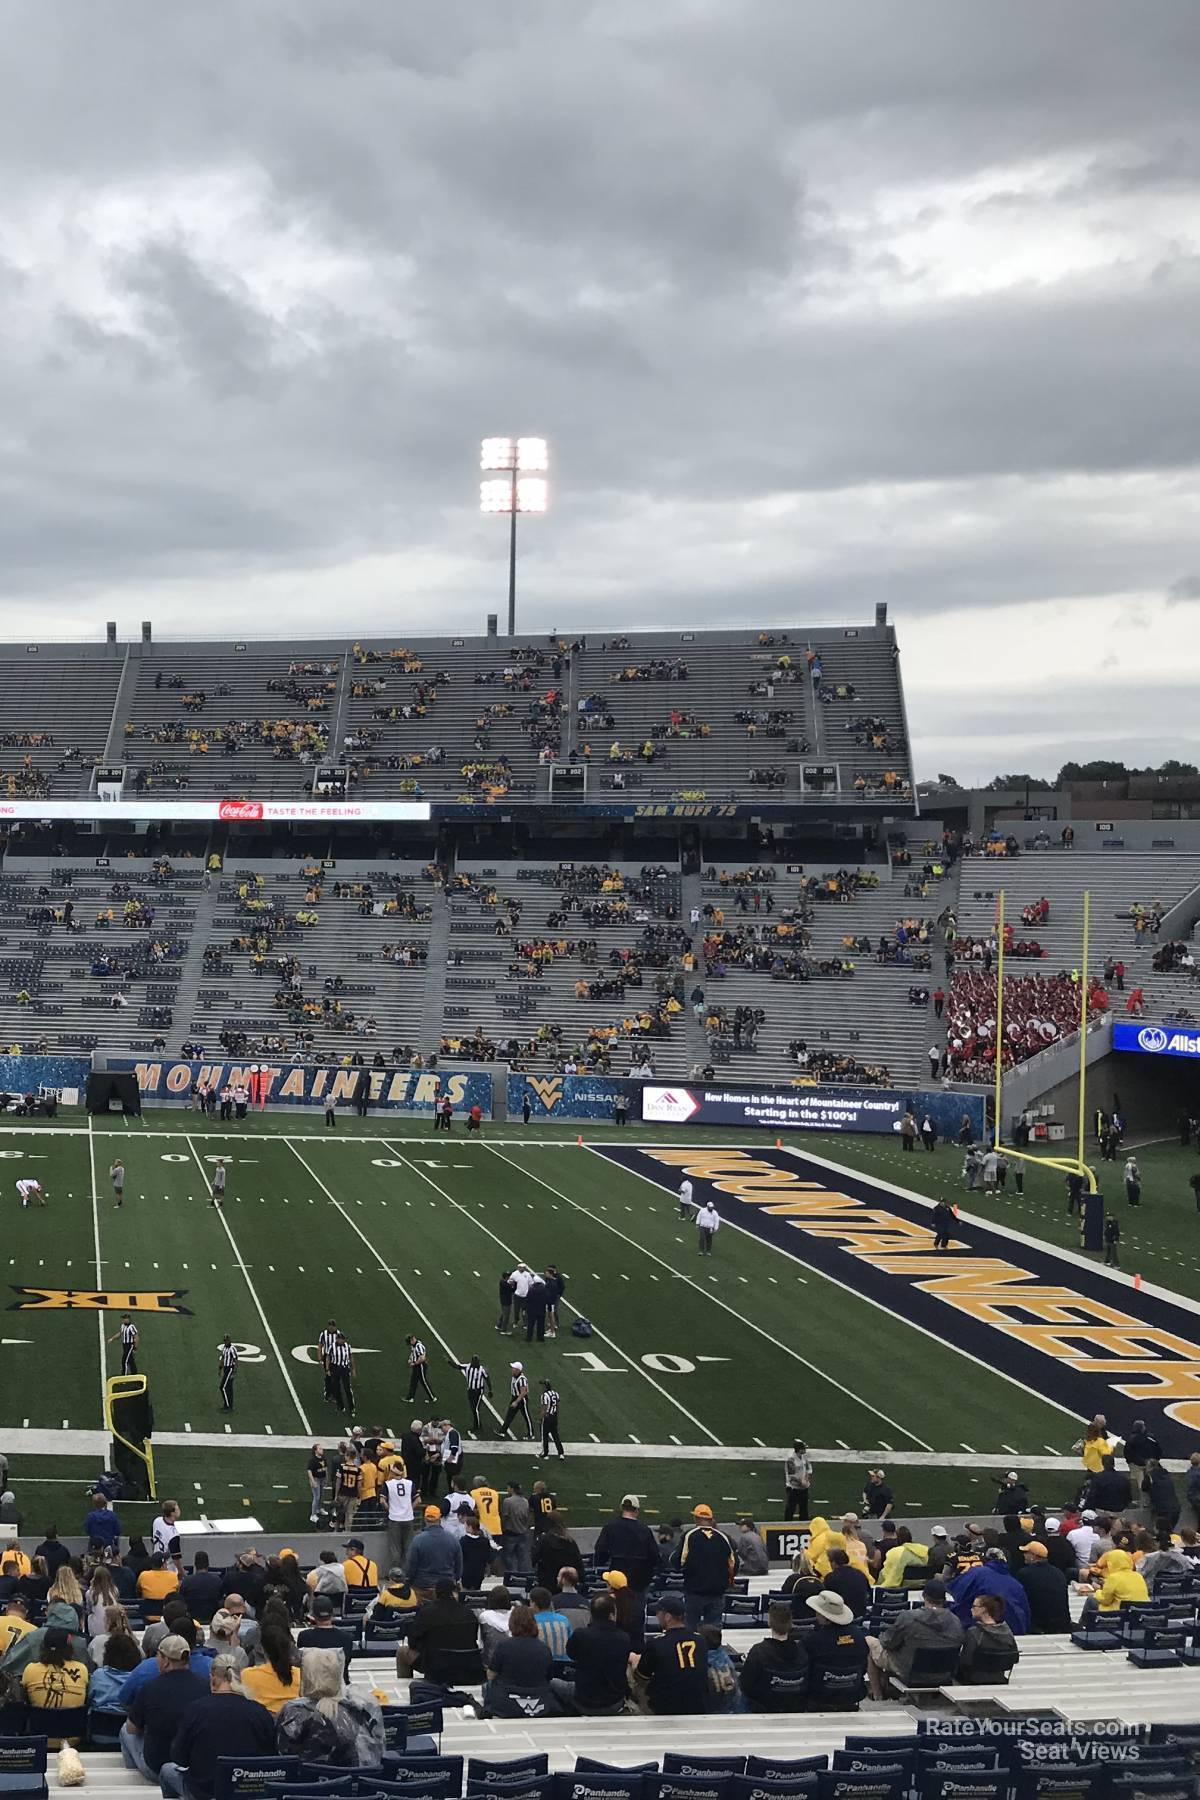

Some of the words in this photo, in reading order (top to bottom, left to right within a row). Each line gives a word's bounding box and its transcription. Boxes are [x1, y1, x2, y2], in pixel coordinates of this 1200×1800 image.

[805, 767, 817, 775] 202
[267, 807, 297, 816] TASTE
[299, 807, 317, 816] THE
[320, 807, 362, 817] FEELING
[634, 804, 668, 817] SAM
[134, 1062, 468, 1103] MOUNTAINEERS
[704, 1092, 722, 1102] New
[723, 1093, 750, 1103] Homes
[751, 1094, 760, 1103] in
[761, 1095, 775, 1104] the
[776, 1095, 798, 1105] Heart
[800, 1096, 809, 1106] of
[810, 1097, 862, 1109] Mountaineer
[863, 1100, 899, 1112] Country!
[744, 1106, 787, 1120] Starting
[788, 1108, 798, 1119] in
[800, 1109, 818, 1120] the
[820, 1109, 857, 1121] $100's!
[636, 1149, 1200, 1432] MOUNTAINEER
[396, 1483, 406, 1498] 8
[481, 1496, 493, 1514] 7
[539, 1498, 552, 1513] 18
[675, 1639, 697, 1669] 17
[860, 1762, 903, 1772] Panhandle
[944, 1761, 986, 1771] Panhandle
[242, 1769, 287, 1779] Panhandle
[406, 1770, 452, 1781] Panhandle
[689, 1767, 734, 1778] Panhandle
[773, 1769, 817, 1780] Panhandle
[582, 1788, 631, 1799] Panhandle
[670, 1787, 719, 1798] Panhandle
[845, 1783, 892, 1793] Panhandle
[951, 1784, 998, 1793] Panhandle
